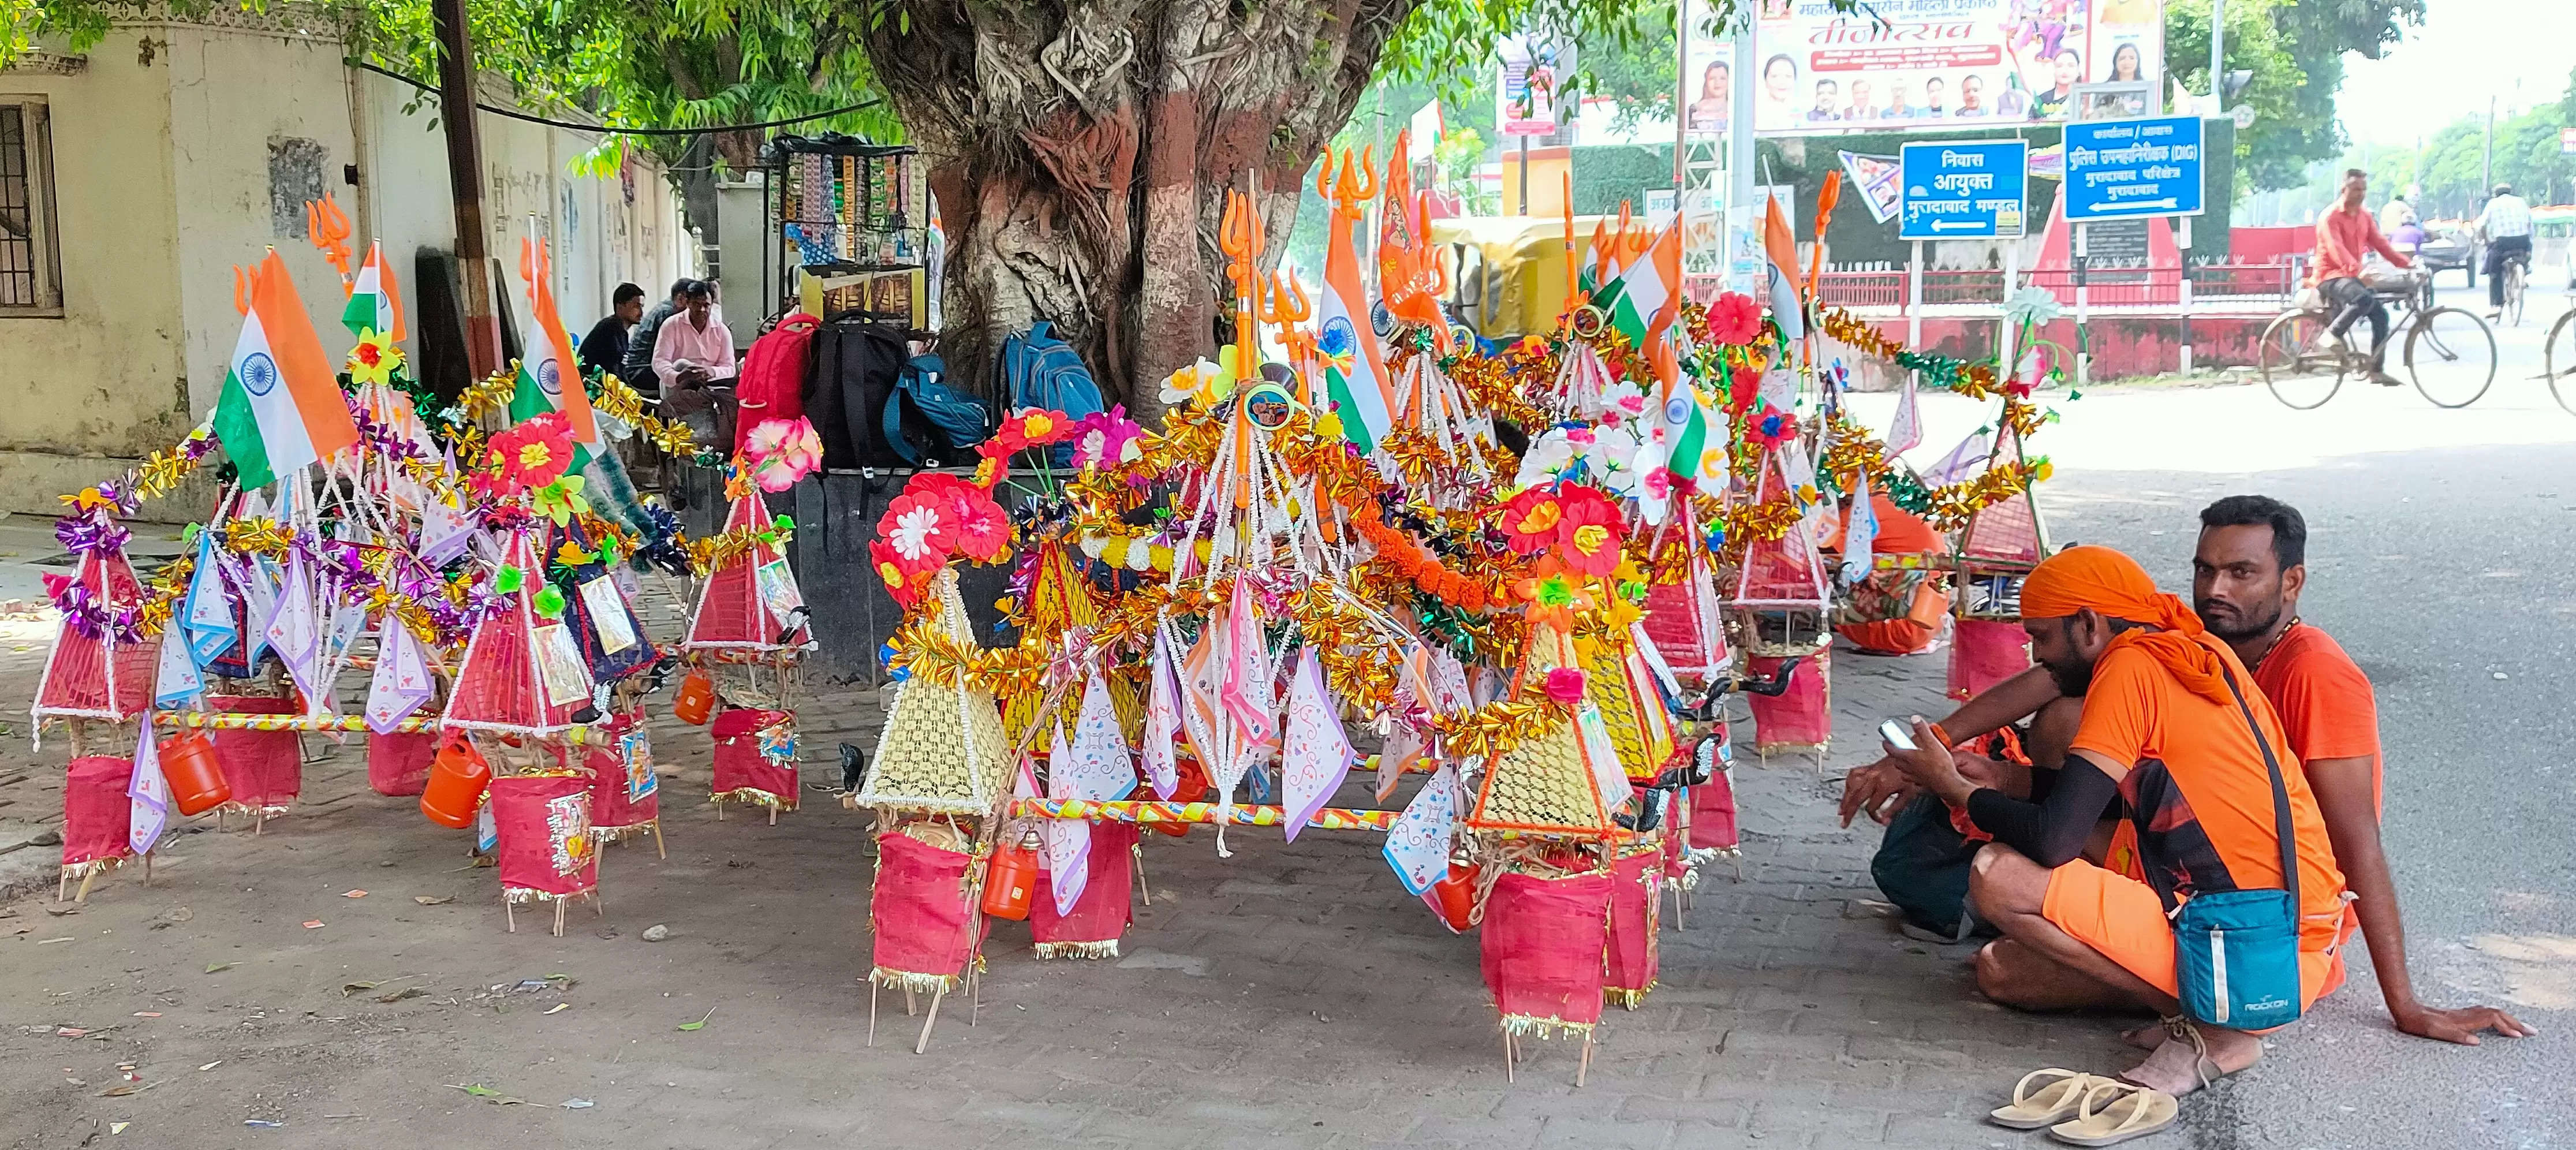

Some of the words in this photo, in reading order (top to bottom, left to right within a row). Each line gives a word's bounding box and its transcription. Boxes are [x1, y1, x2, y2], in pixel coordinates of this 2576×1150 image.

[1809, 17, 1977, 44] तीजोत्सव
[1941, 149, 1985, 168] निवास
[2069, 145, 2097, 171] पुलिस
[2171, 144, 2198, 162] (DIG)
[1934, 173, 1994, 196] आयुक्त
[2085, 170, 2137, 188] मुरादाबाद
[2107, 184, 2159, 201] मुरादाबाद
[1907, 200, 1971, 219] मुरादाबाद
[1975, 199, 2019, 214] मण्डल
[2244, 999, 2288, 1011] ROCKON
